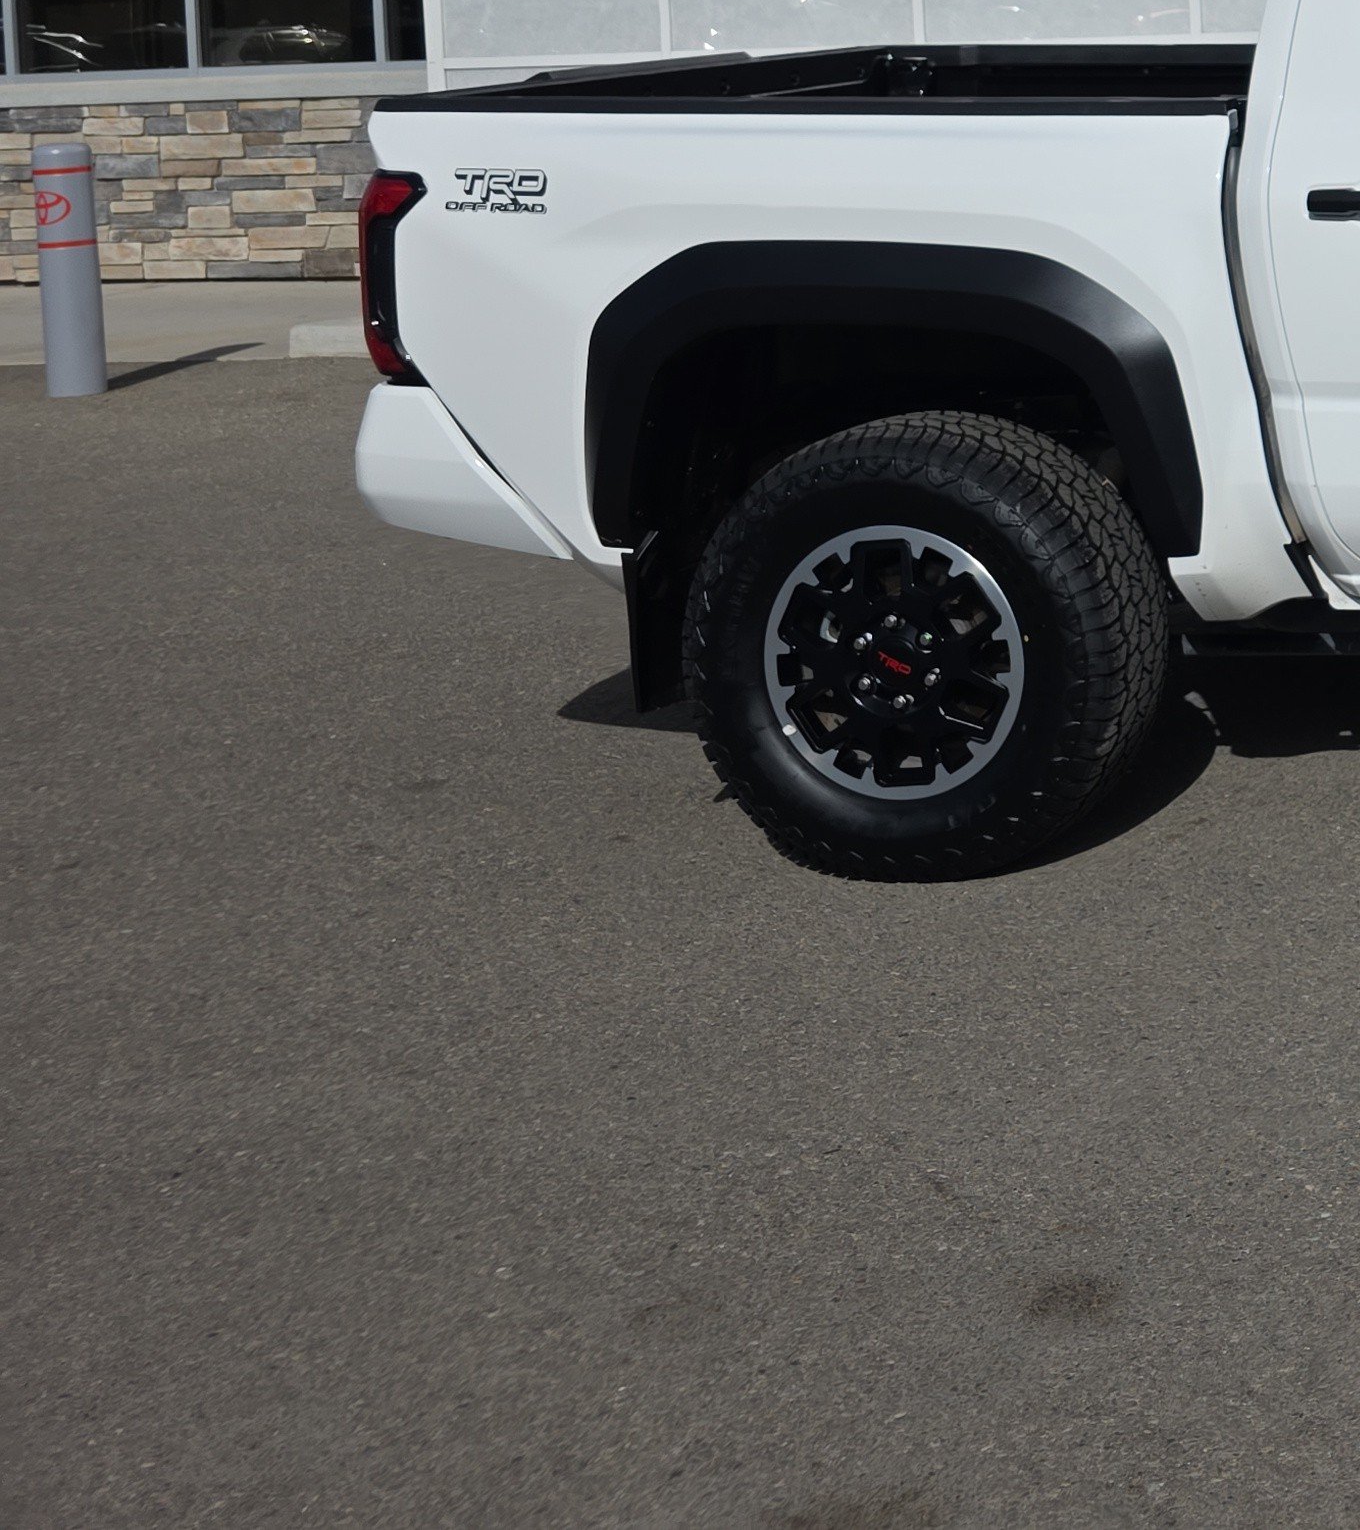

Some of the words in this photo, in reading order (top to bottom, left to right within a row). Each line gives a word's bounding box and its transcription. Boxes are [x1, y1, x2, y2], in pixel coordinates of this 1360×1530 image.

[455, 168, 547, 202] TRD
[445, 201, 487, 212] OFF
[490, 202, 547, 214] ROAD
[877, 650, 913, 675] TRD
